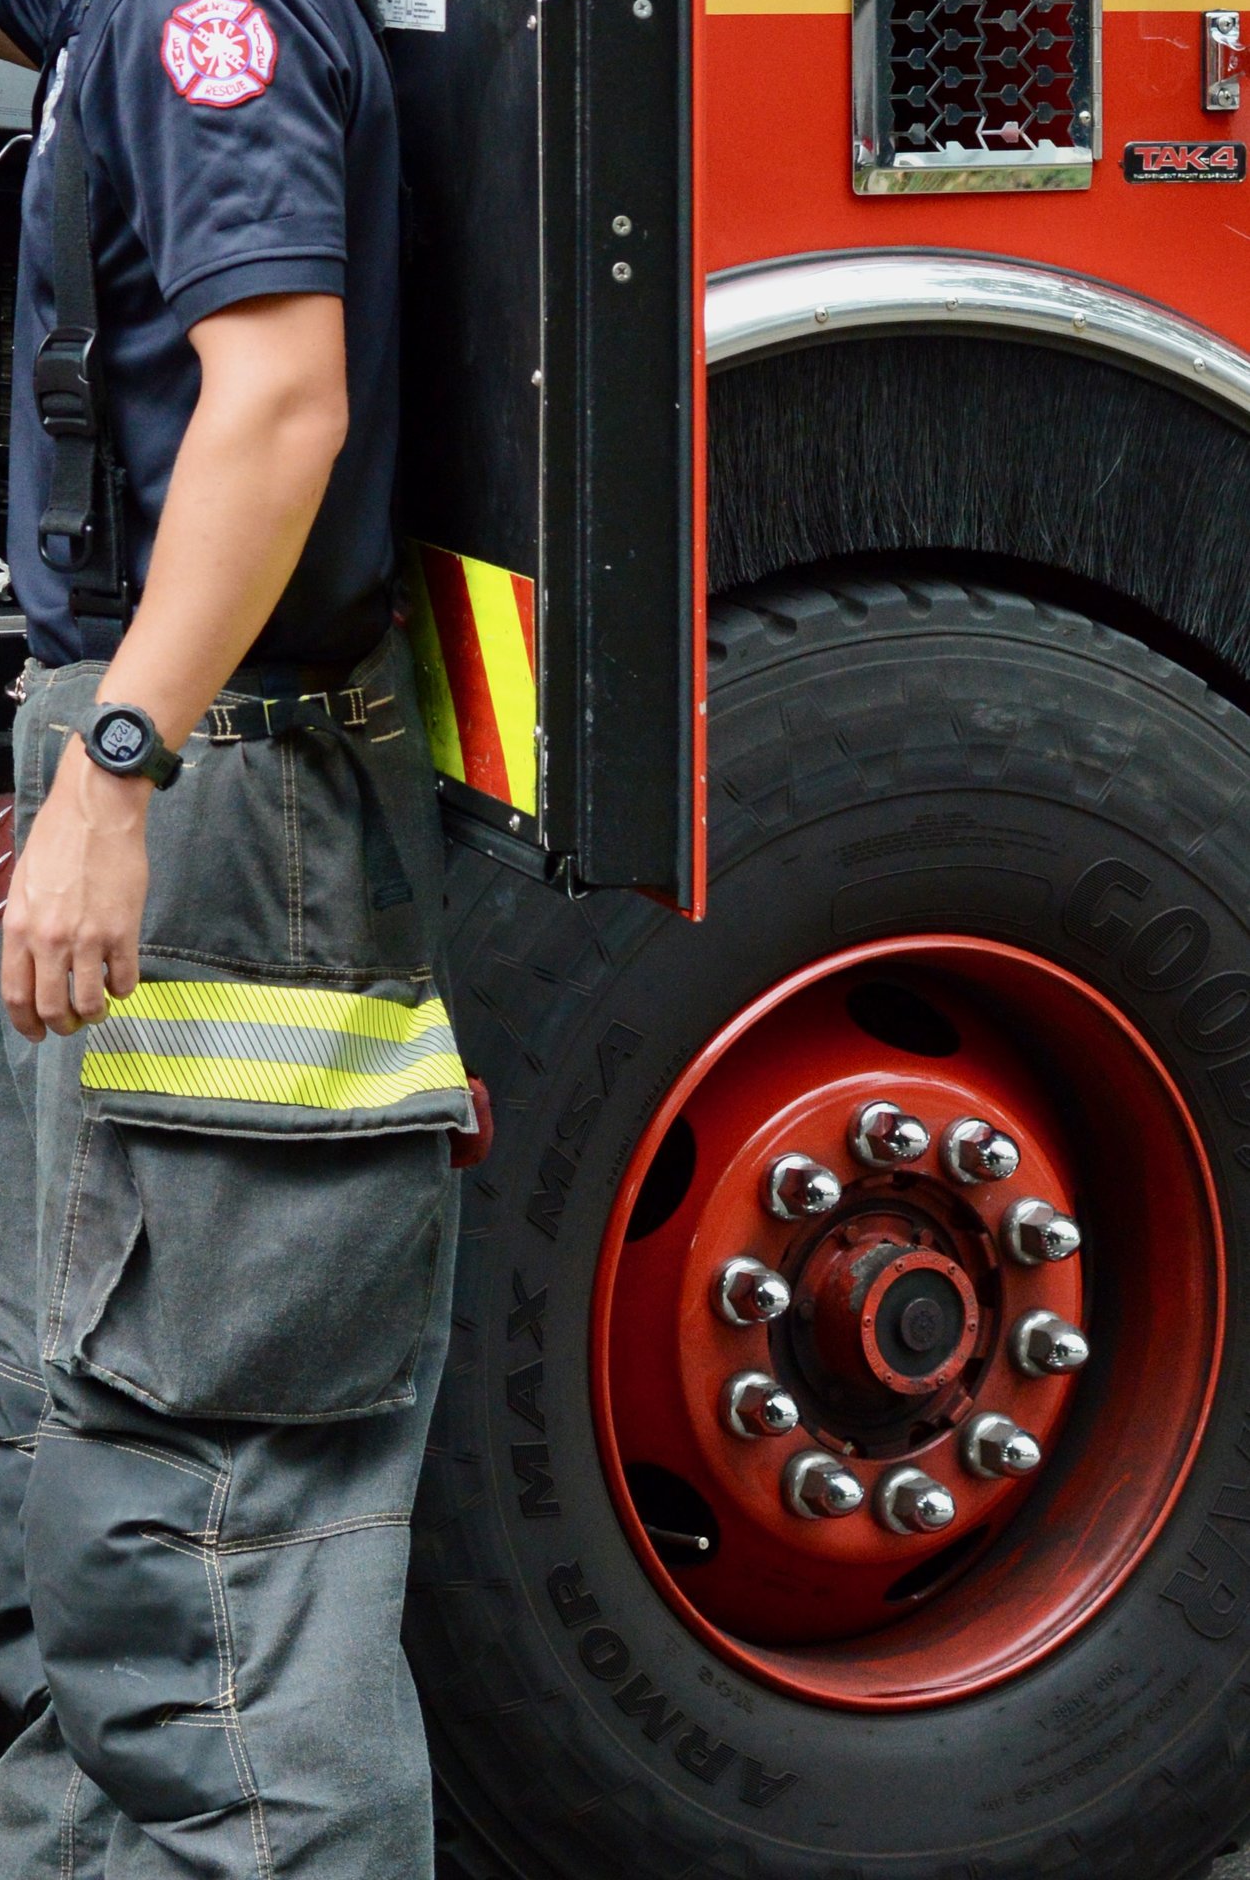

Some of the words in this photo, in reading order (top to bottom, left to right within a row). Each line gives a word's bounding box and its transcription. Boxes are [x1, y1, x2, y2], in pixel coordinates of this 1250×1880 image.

[172, 37, 185, 76] EMT
[252, 23, 266, 69] FIRE
[204, 80, 248, 96] RESCUE
[1134, 146, 1238, 170] TAK-4
[526, 1018, 645, 1241] MSA
[505, 1266, 563, 1519] MAX
[546, 1557, 801, 1809] ARMOR
